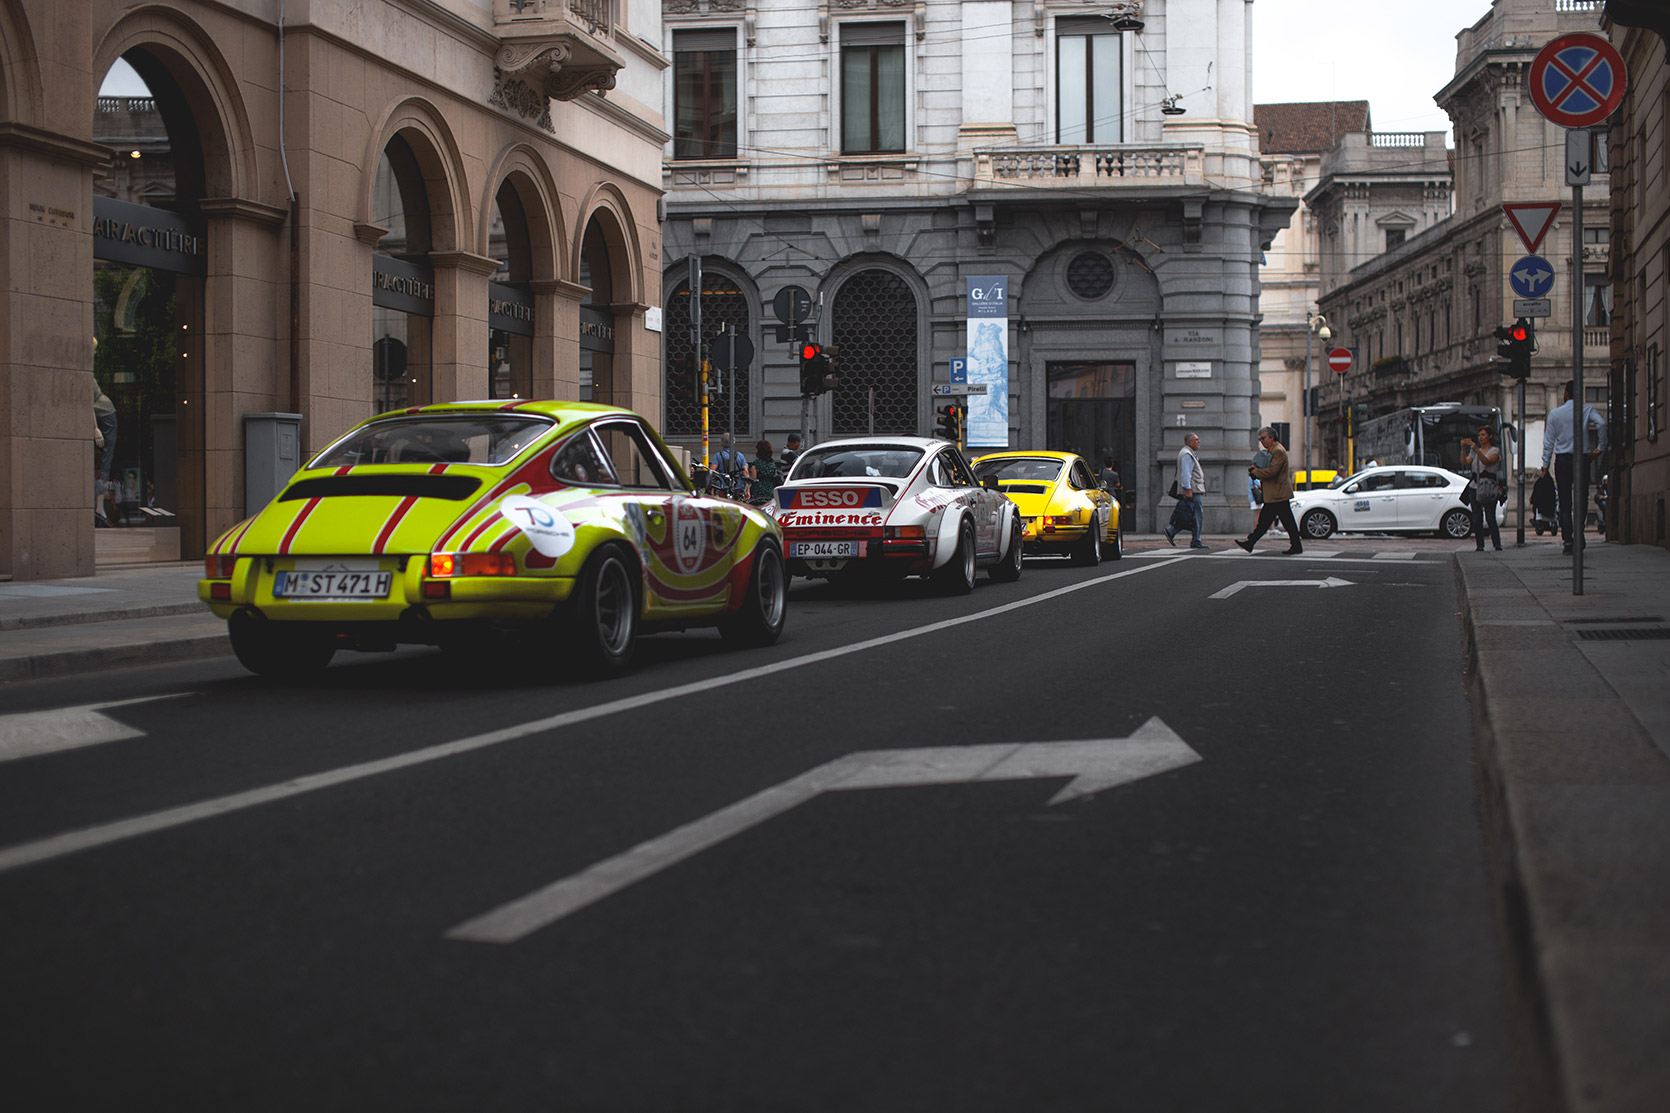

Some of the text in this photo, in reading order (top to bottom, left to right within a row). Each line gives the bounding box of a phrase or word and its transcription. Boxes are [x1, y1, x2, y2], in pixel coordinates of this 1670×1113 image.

[953, 360, 964, 374] P
[800, 490, 859, 507] ESSO
[777, 511, 883, 528] Eminence
[683, 516, 697, 551] 64
